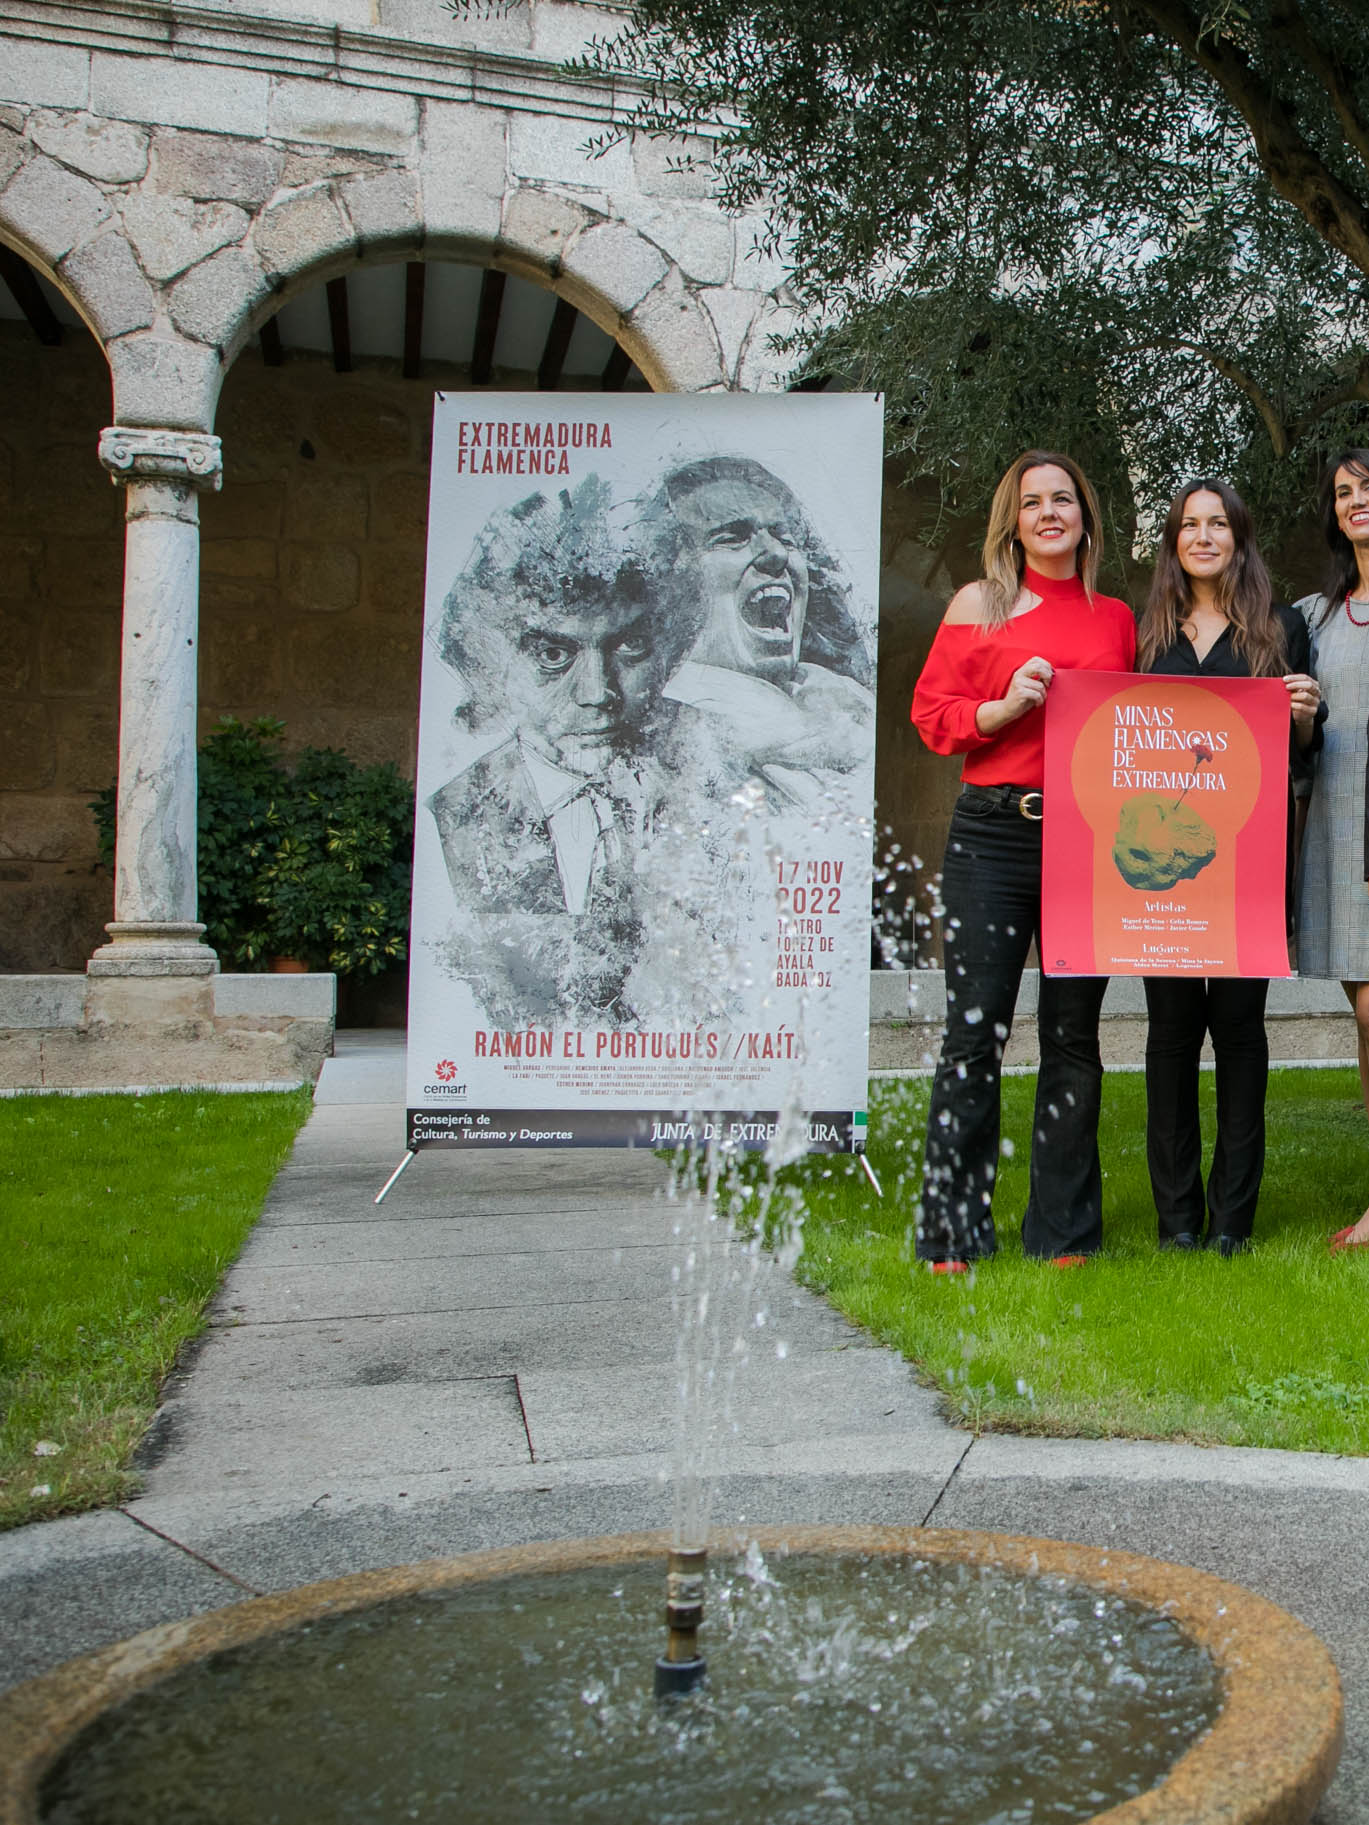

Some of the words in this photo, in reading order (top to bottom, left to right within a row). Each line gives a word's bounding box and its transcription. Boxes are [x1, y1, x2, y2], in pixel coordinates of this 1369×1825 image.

[458, 422, 612, 448] EXTREMADURA
[457, 449, 570, 475] FLAMENCA
[1114, 704, 1174, 727] MINAS
[1113, 727, 1228, 752] FLAMENCAS
[1113, 749, 1136, 768] DE
[1112, 769, 1226, 791] EXTREMADURA
[777, 861, 800, 884] 17
[807, 860, 844, 884] NOV
[1144, 900, 1187, 913] Artistas
[820, 936, 835, 952] DE
[1142, 943, 1190, 956] Lugares
[776, 954, 814, 970] AYALA
[776, 971, 832, 987] BADAOZ
[474, 1022, 553, 1057] RAMÓN
[563, 1031, 585, 1057] EL
[424, 1083, 467, 1094] cemart
[413, 1113, 473, 1127] Consejería
[476, 1114, 491, 1125] de
[412, 1128, 458, 1141] Cultura,
[461, 1128, 507, 1140] Turismo
[508, 1131, 517, 1142] y
[519, 1128, 573, 1142] Deportes
[650, 1122, 695, 1142] JUNTA
